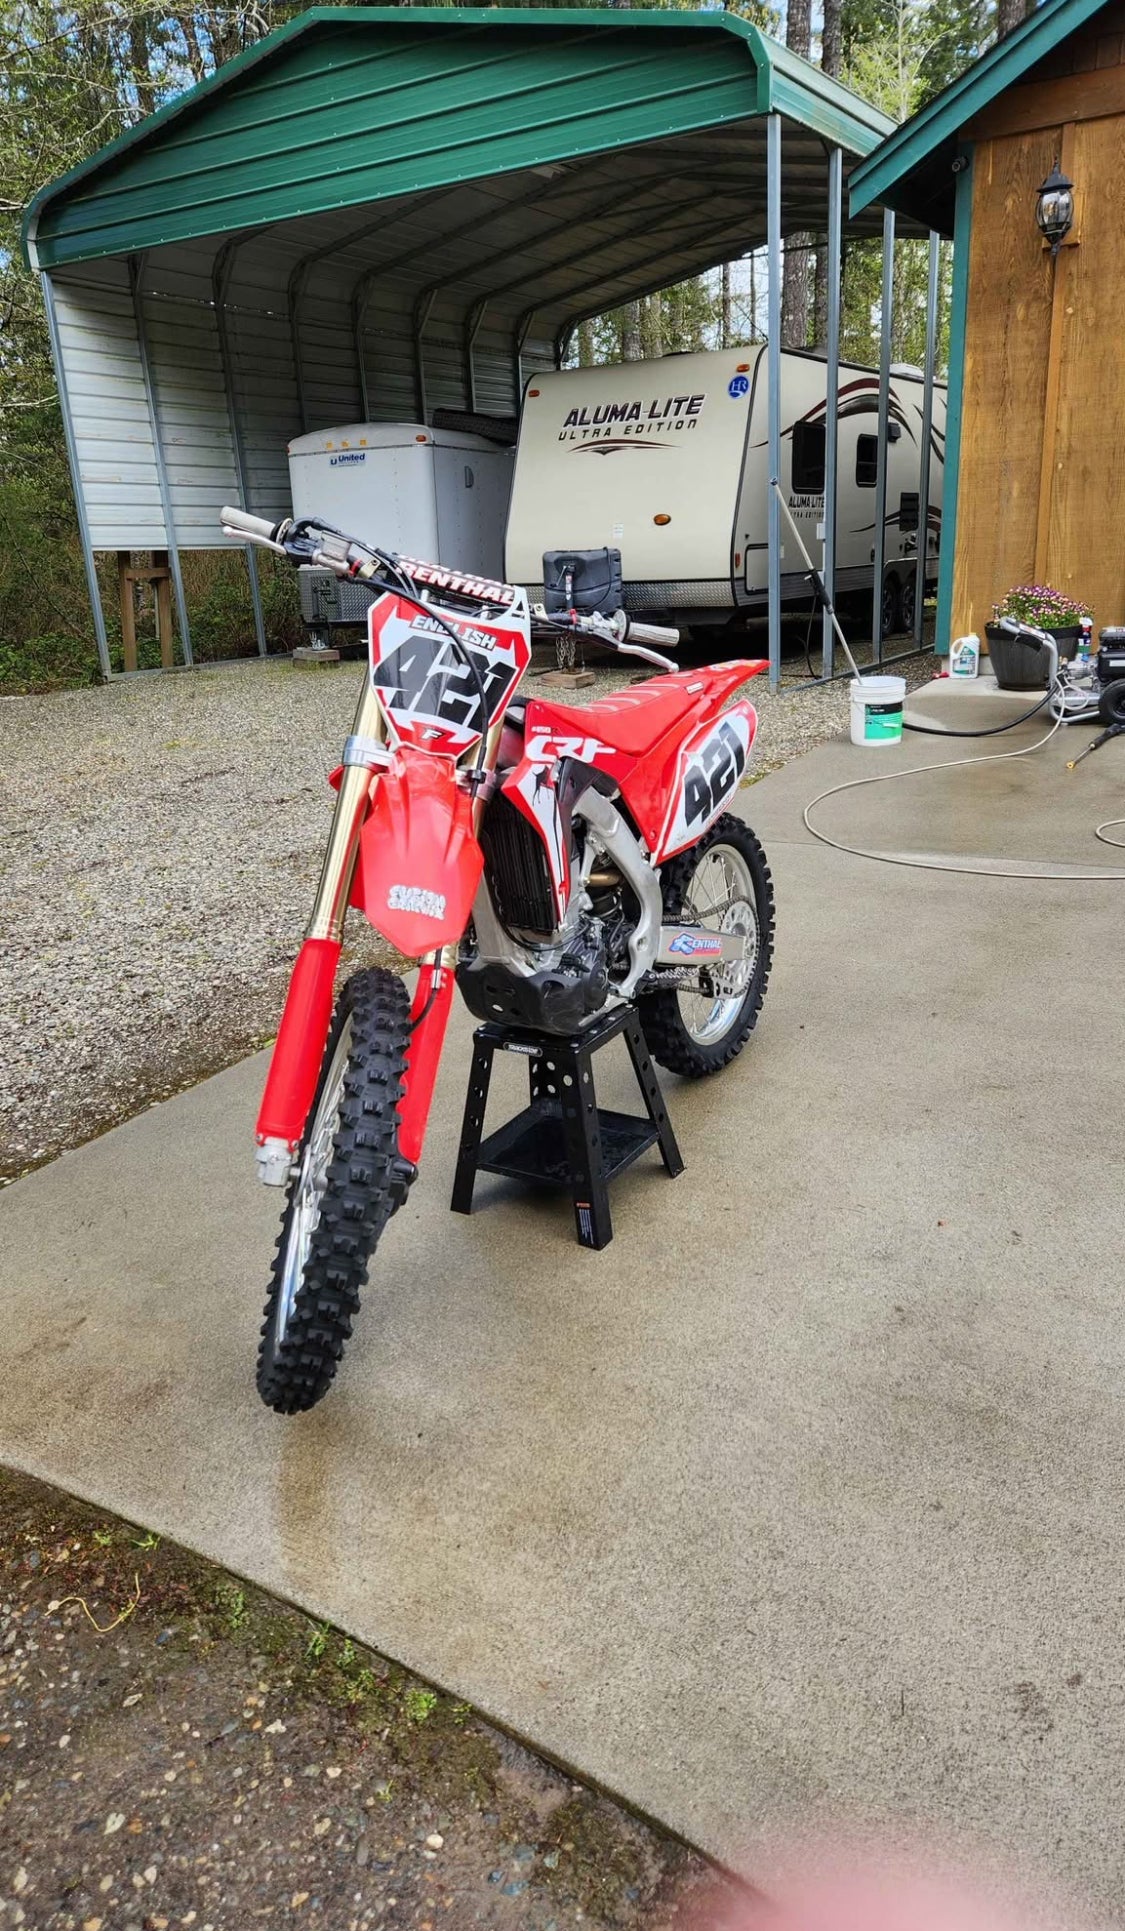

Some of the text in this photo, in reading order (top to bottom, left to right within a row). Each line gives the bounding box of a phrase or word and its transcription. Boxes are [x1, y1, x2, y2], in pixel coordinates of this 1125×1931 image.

[563, 394, 706, 428] ALUMA-LITE
[558, 419, 698, 441] ULTRA EDITION
[338, 453, 365, 462] United
[374, 635, 518, 733] 421
[525, 735, 617, 764] CRF
[684, 721, 745, 827] 421
